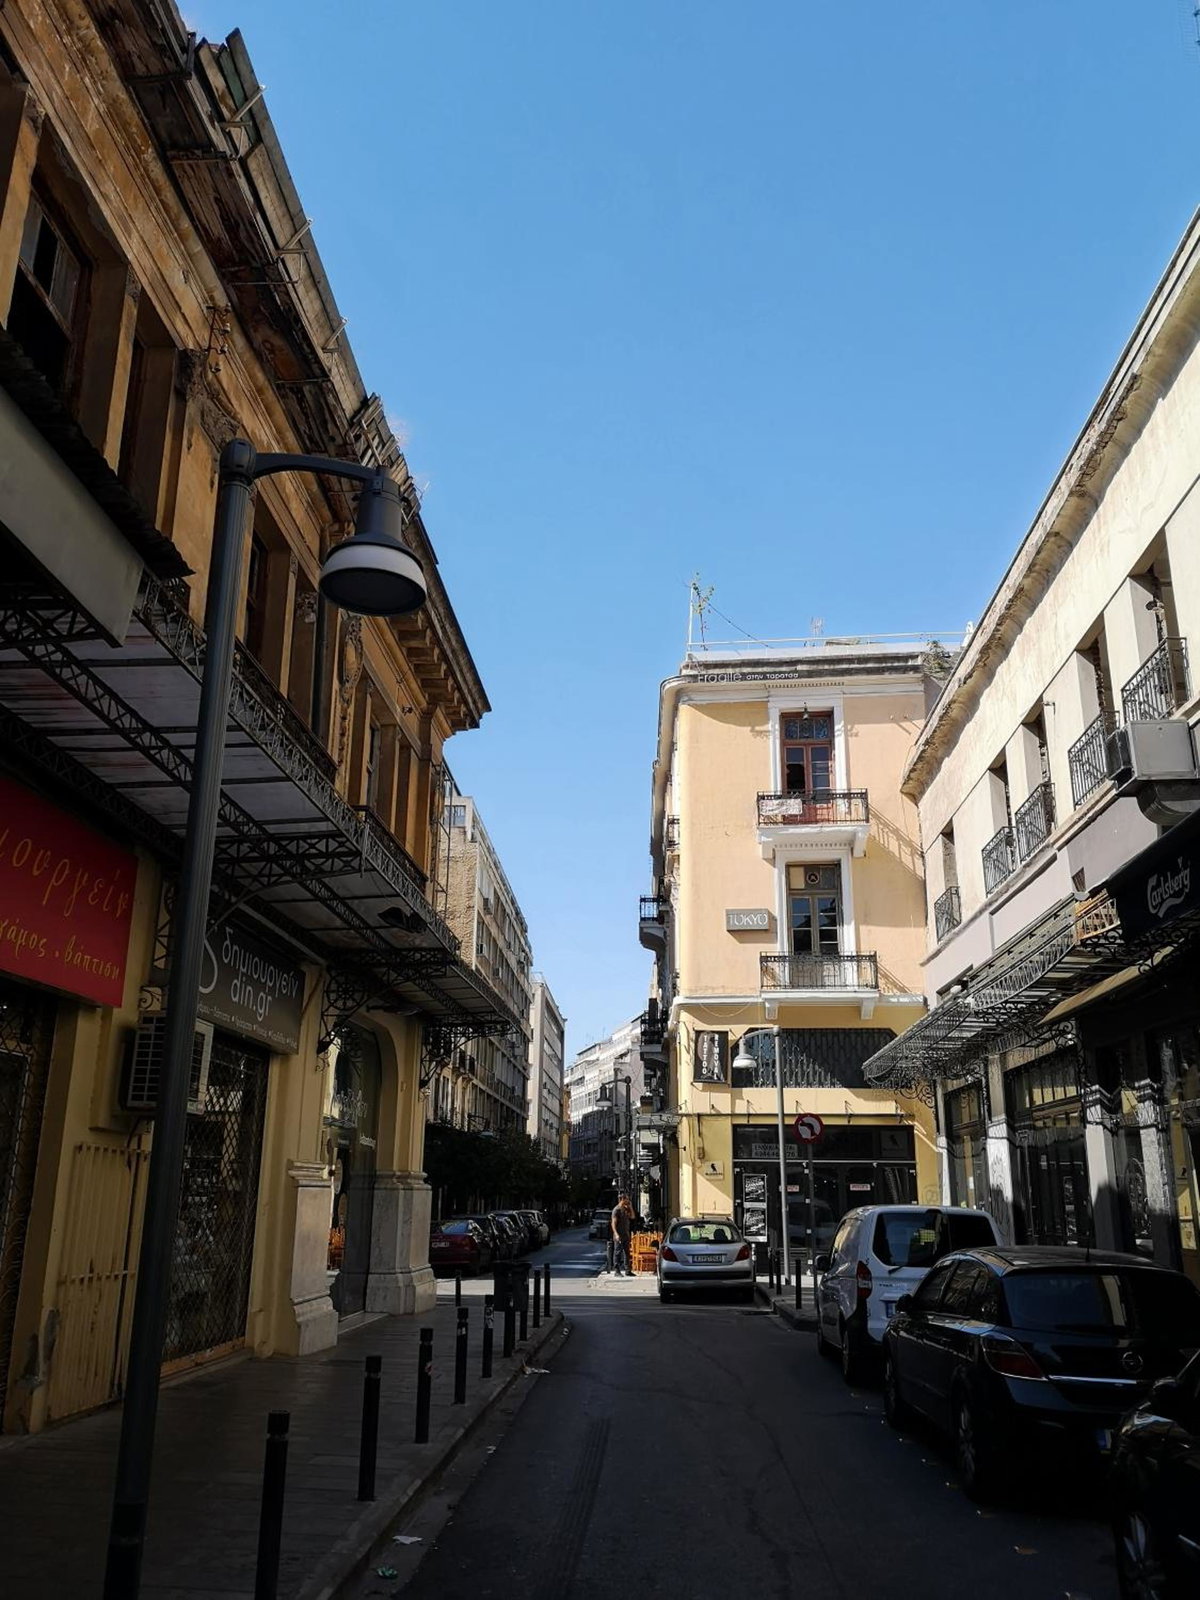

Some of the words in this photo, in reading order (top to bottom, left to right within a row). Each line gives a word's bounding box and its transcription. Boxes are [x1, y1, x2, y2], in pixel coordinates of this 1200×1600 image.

[1147, 863, 1190, 914] Carlsberg
[727, 913, 768, 926] TOKYO
[222, 926, 299, 999] δημιουργείν
[230, 972, 273, 1022] din.gr
